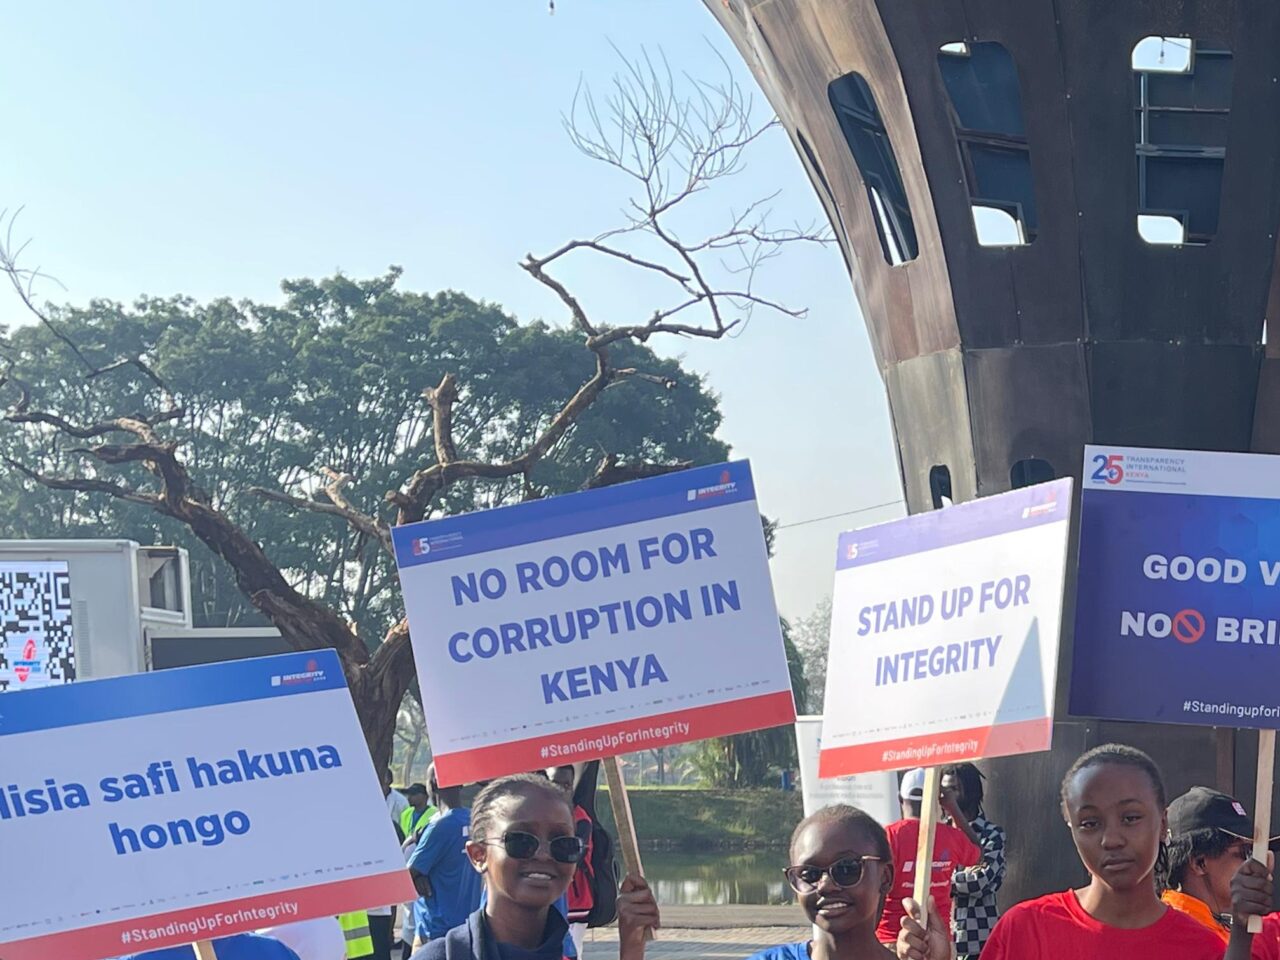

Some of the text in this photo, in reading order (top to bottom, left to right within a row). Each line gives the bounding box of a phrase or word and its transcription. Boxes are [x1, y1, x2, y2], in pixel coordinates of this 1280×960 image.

[1091, 455, 1124, 484] 25
[451, 527, 717, 605] NO ROOM FOR
[1143, 554, 1247, 584] GOOD
[447, 580, 741, 663] CORRUPTION IN
[857, 574, 1031, 637] STAND UP FOR
[1120, 611, 1172, 639] NO
[540, 653, 668, 704] KENYA
[875, 635, 1003, 687] INTEGRITY
[540, 722, 691, 759] #StandingUpForIntegrity
[882, 739, 978, 762] #StandingUpForIntegrity
[99, 760, 180, 802] safi
[186, 744, 342, 789] hakuna
[108, 810, 250, 855] hongo
[121, 901, 299, 946] #StandingUpForIntegrity
